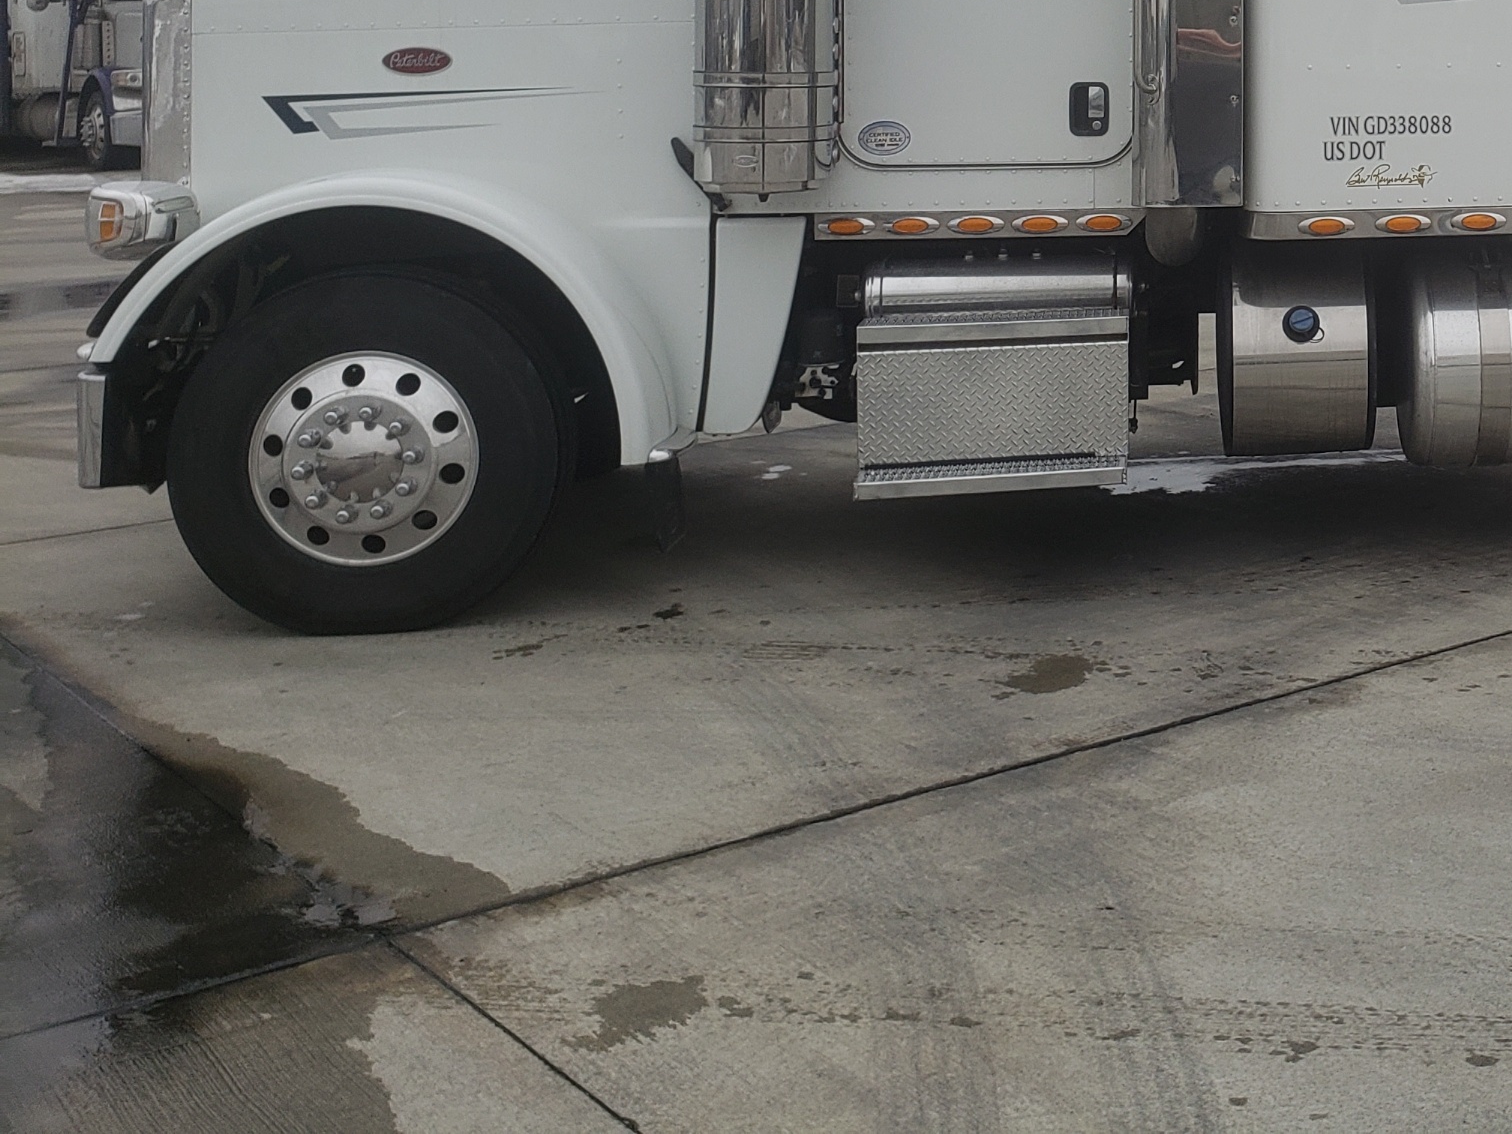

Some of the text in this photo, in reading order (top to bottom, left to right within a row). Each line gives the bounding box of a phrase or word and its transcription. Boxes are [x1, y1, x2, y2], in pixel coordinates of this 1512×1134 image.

[390, 52, 446, 68] Peterbilt
[1330, 115, 1452, 136] VIN GD338088
[1323, 140, 1386, 161] US DOT
